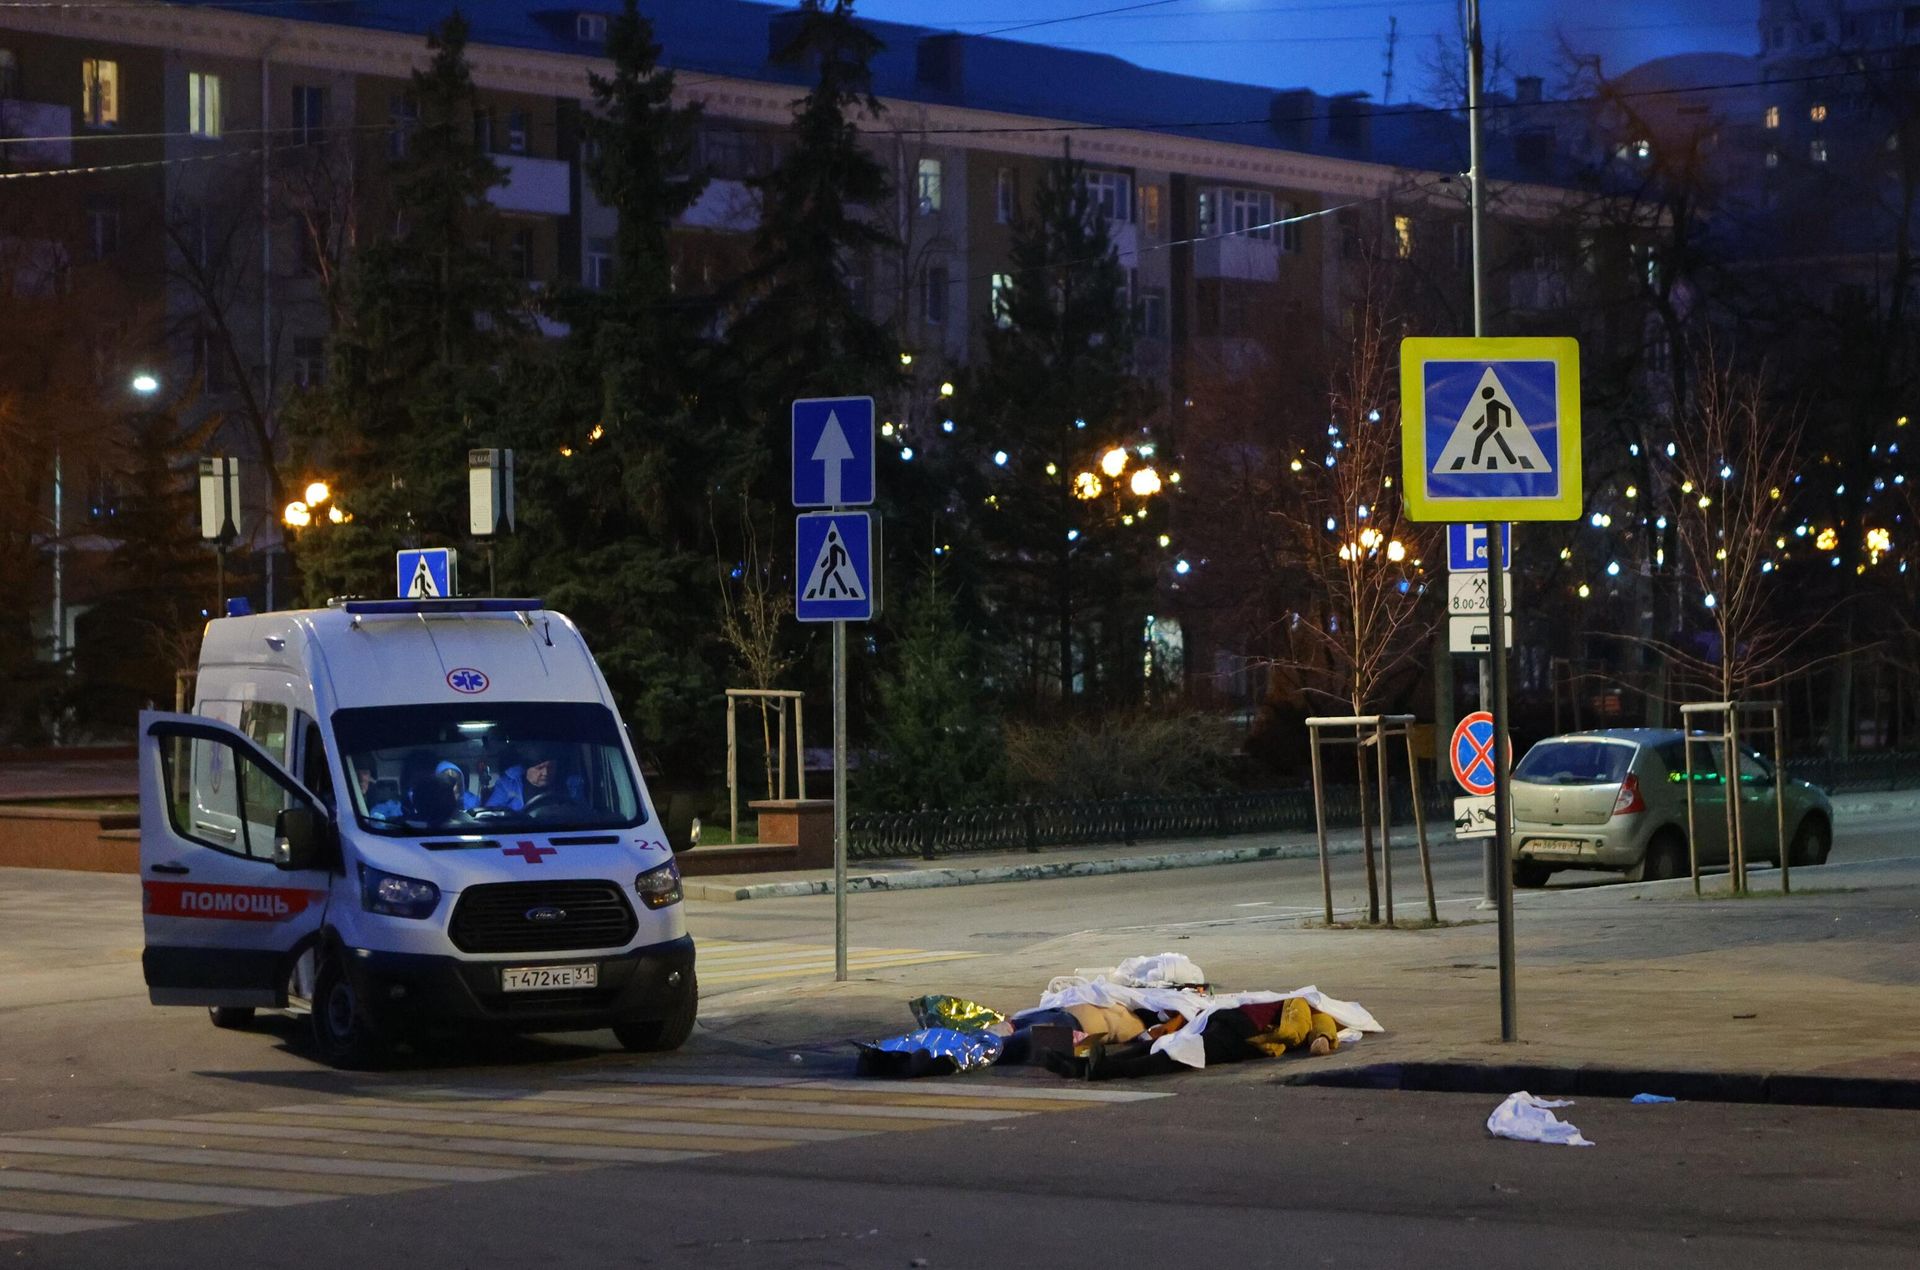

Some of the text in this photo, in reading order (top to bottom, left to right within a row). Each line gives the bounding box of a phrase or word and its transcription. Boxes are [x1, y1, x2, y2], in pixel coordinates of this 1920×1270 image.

[634, 839, 667, 852] 21
[180, 891, 289, 917] ПОМОЩЬ
[575, 967, 591, 980] 31
